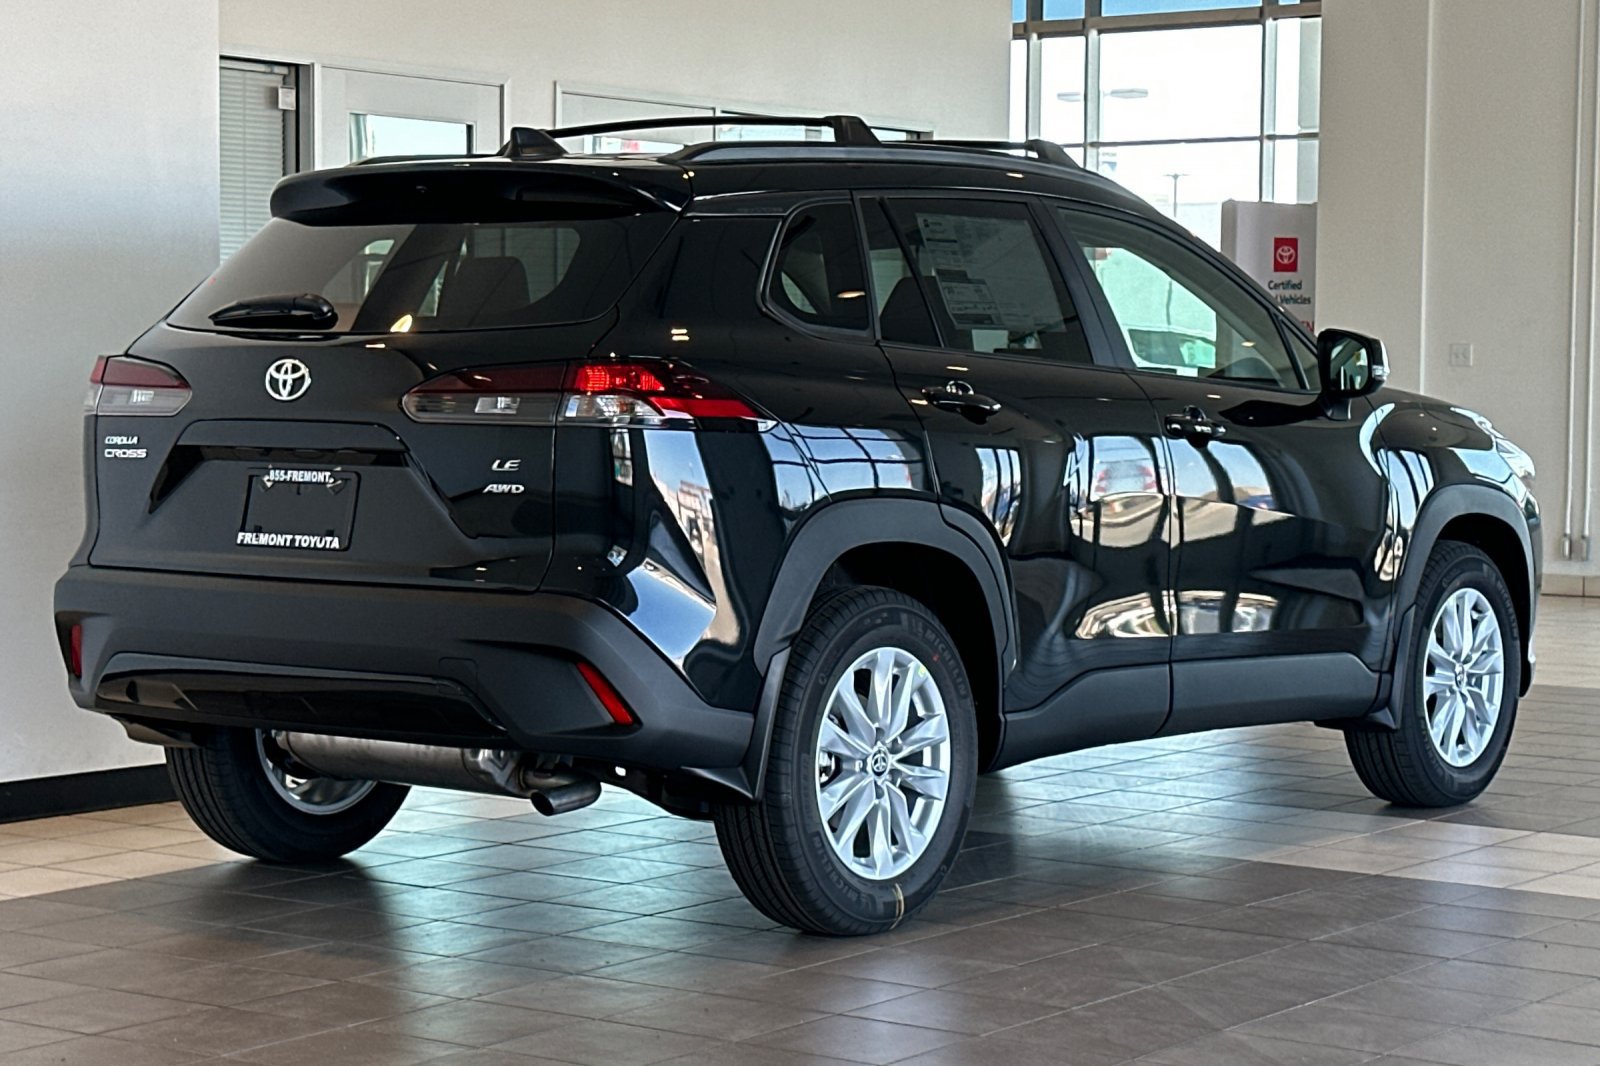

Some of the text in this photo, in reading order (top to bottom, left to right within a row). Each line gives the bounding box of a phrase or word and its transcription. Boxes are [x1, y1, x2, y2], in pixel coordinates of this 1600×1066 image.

[1268, 280, 1302, 290] Certified
[105, 436, 139, 445] COROLLA
[104, 448, 148, 458] CROSS
[491, 459, 522, 471] LE
[269, 469, 332, 482] 855-FREMONT
[482, 484, 525, 493] AWD
